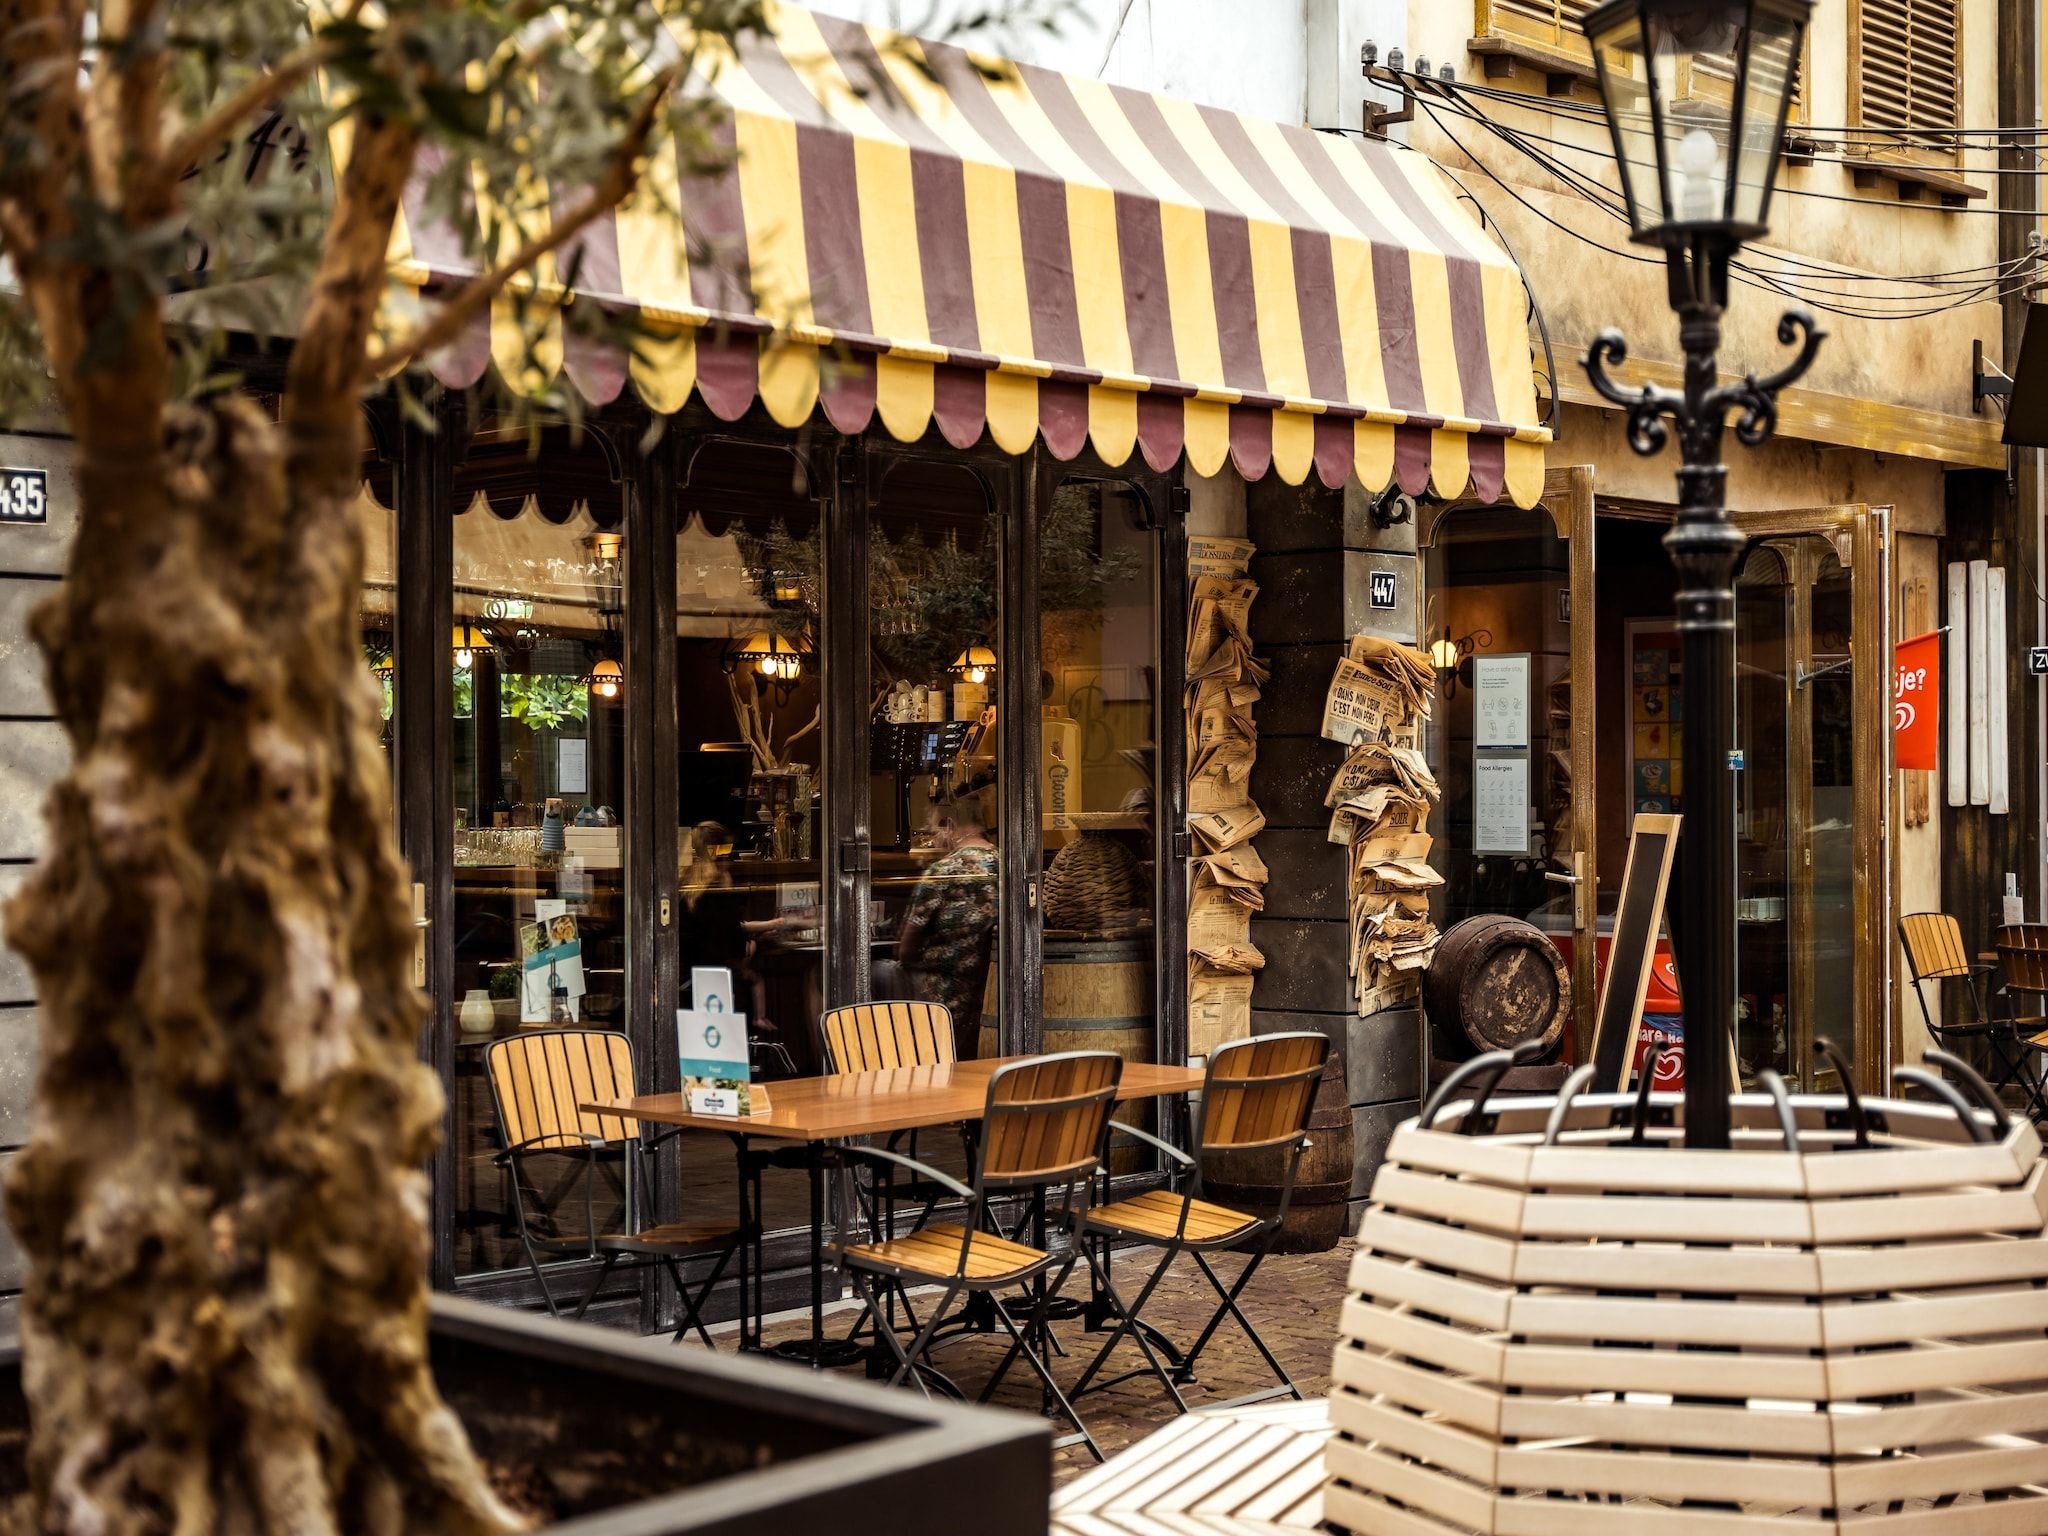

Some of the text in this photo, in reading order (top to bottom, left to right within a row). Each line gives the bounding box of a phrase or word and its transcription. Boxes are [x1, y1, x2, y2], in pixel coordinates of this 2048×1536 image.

[0, 476, 43, 514] 435
[1374, 578, 1394, 603] 447
[2035, 653, 2048, 668] Z
[1896, 665, 1926, 698] je?
[1389, 812, 1409, 825] SOIR
